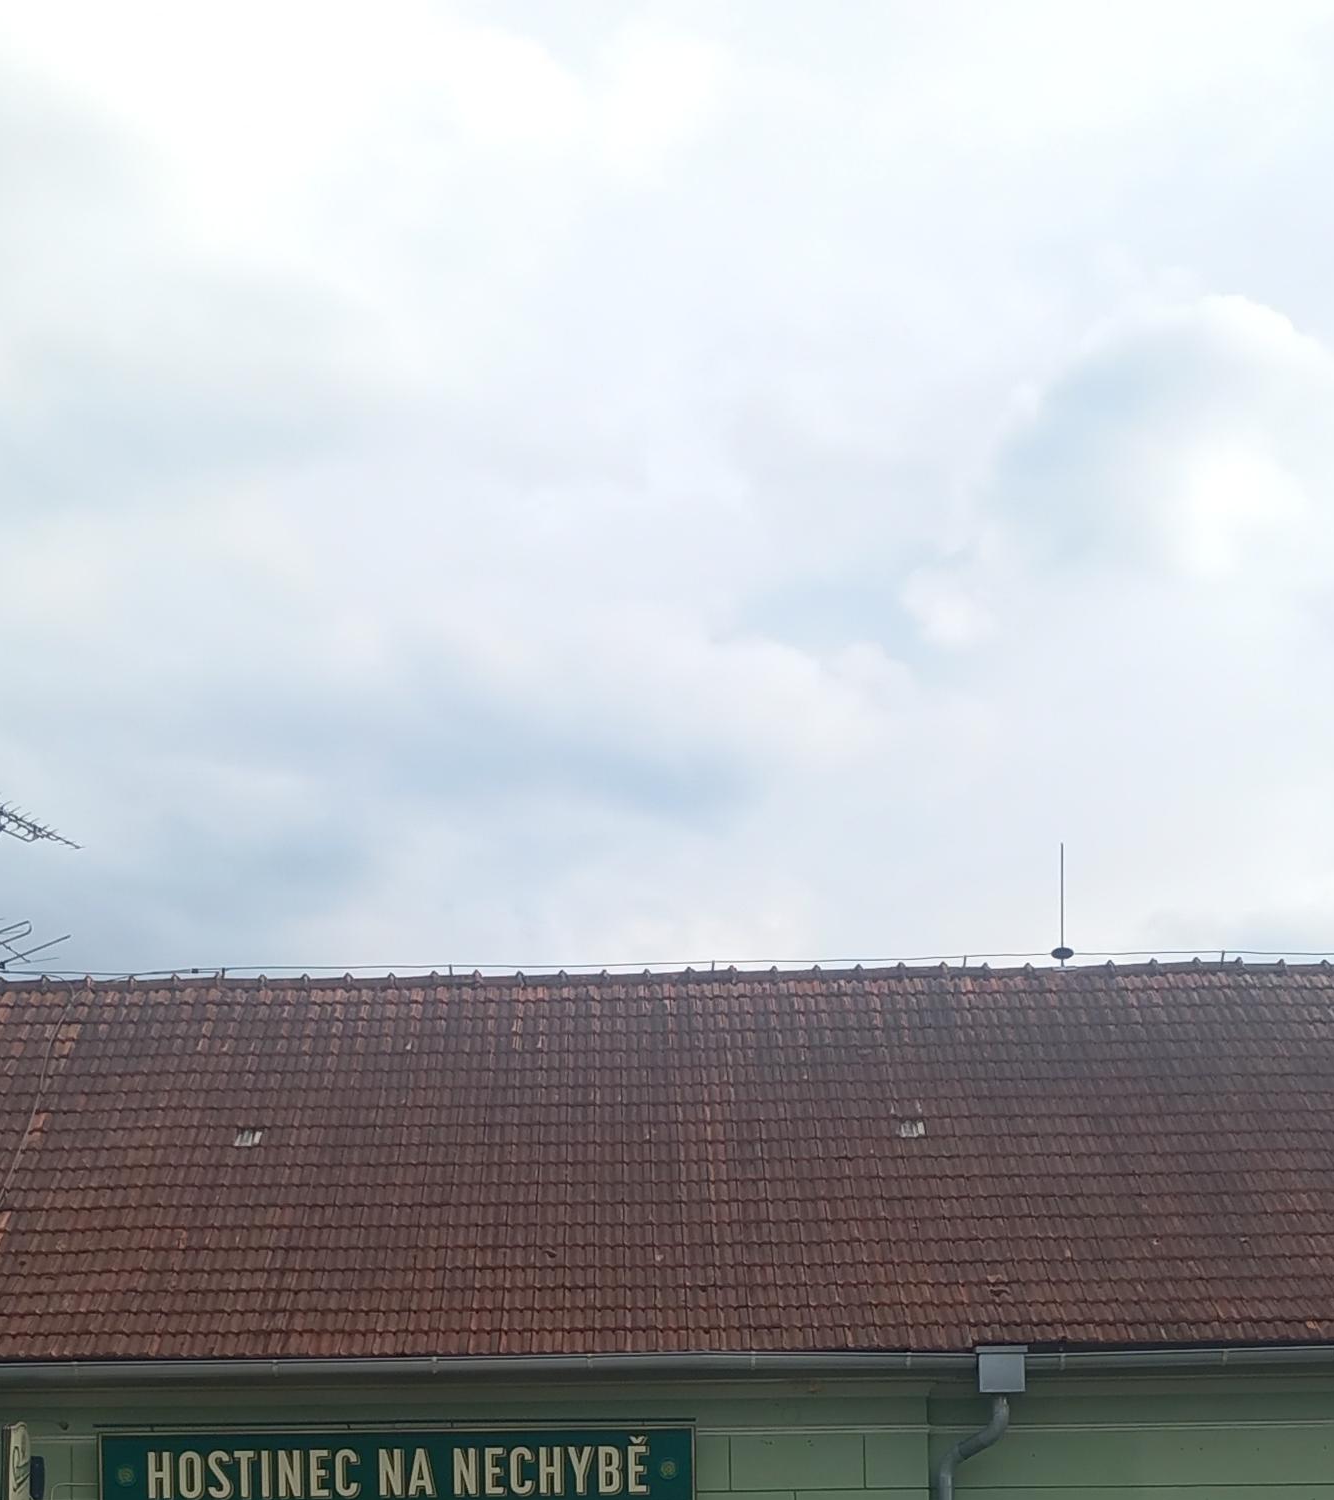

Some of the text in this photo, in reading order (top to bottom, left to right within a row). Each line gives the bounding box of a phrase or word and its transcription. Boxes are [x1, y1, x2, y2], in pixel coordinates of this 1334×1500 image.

[147, 1436, 650, 1500] HOSTINEC NA NECHYBĚ
